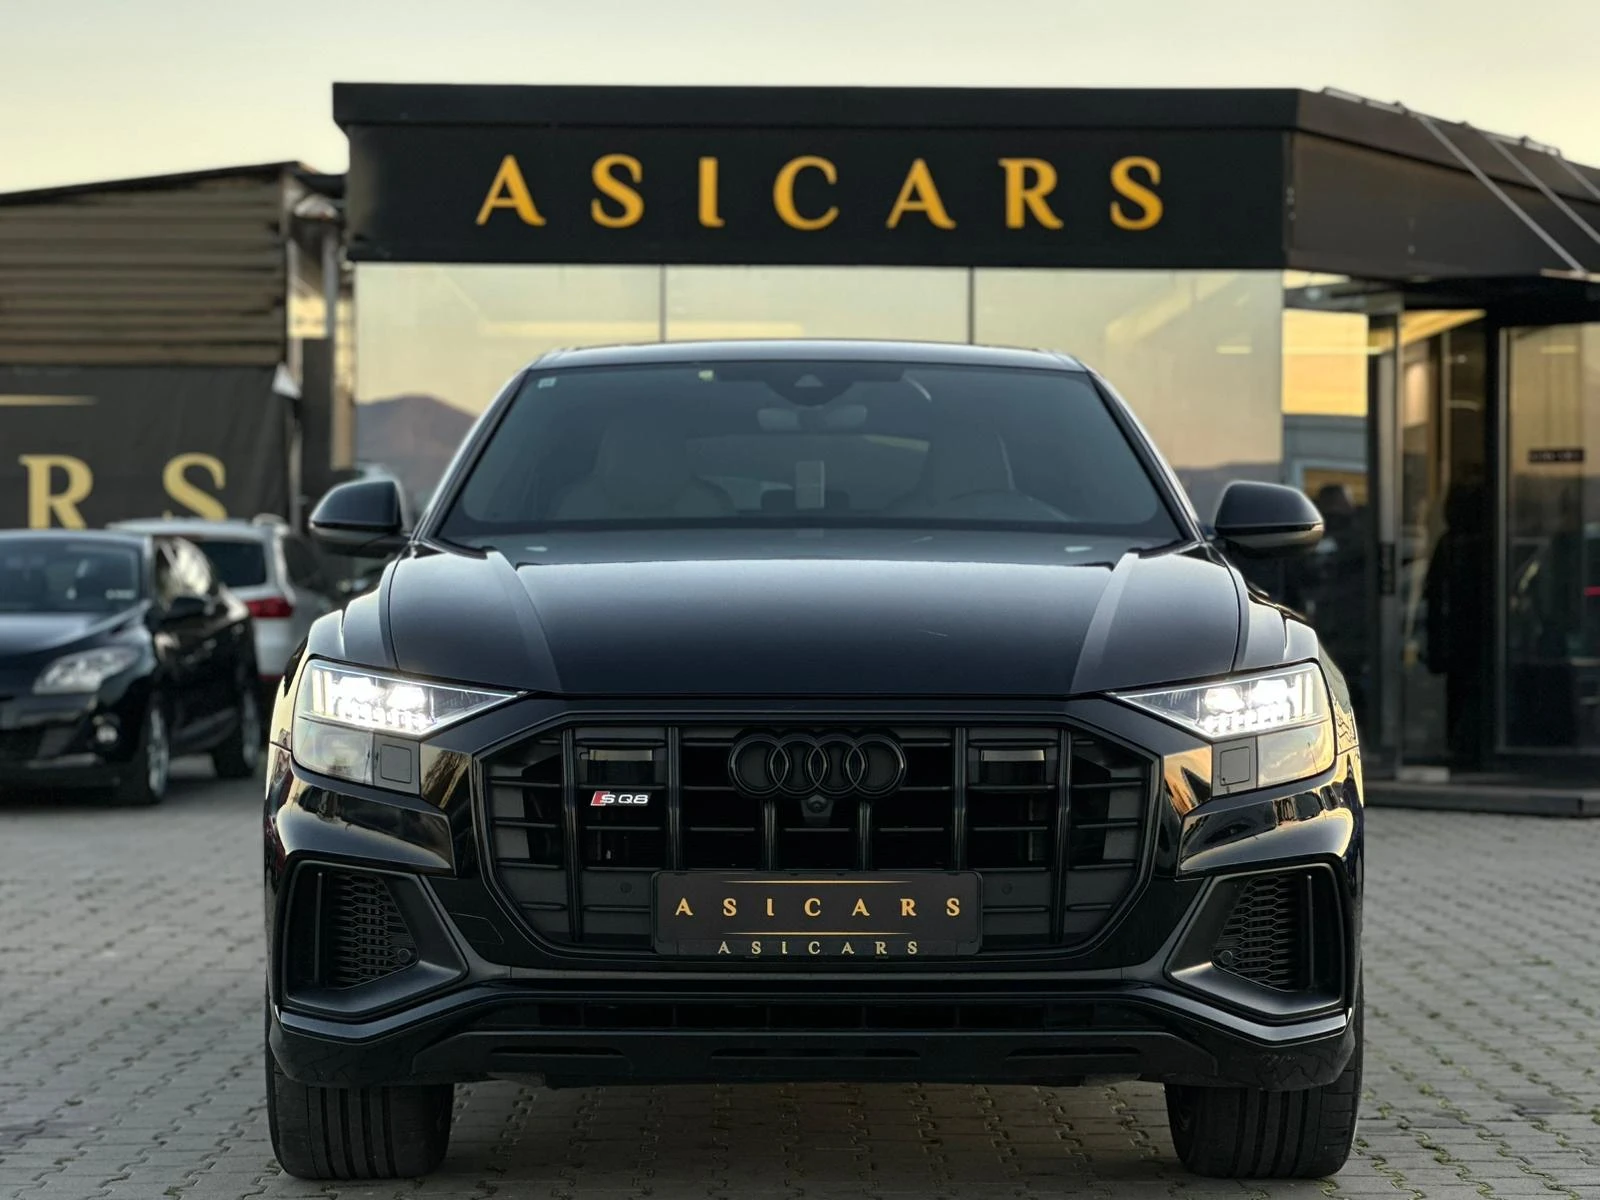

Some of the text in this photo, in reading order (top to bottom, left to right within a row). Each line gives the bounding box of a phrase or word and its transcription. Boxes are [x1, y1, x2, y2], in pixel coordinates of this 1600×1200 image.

[475, 154, 1164, 231] ASICARS
[599, 793, 649, 804] SQ8
[675, 897, 961, 917] ASICARS
[717, 940, 919, 955] ASICARS
